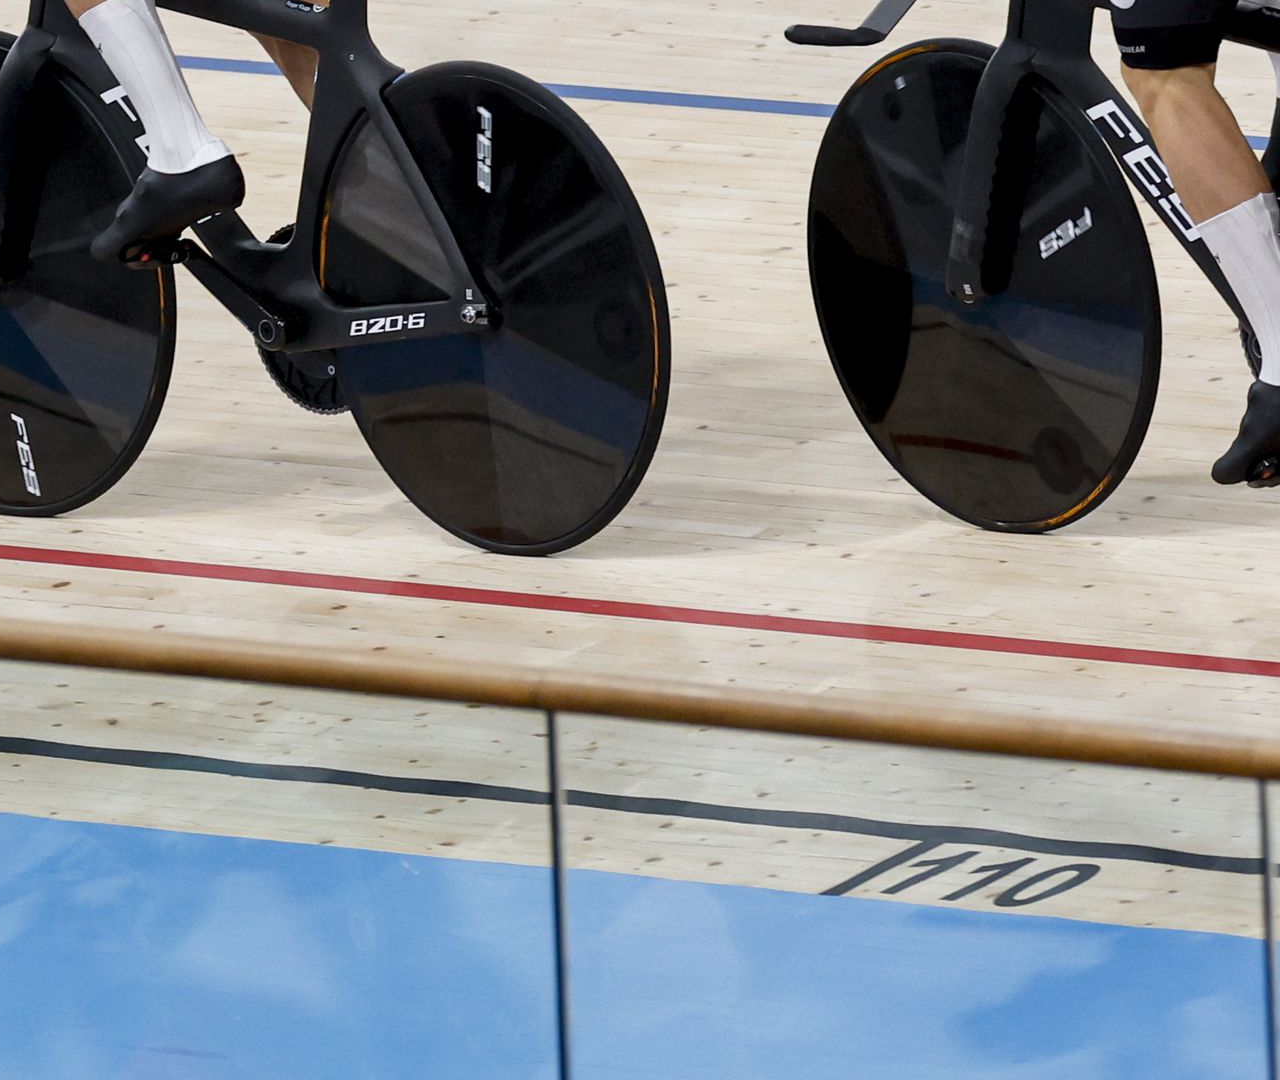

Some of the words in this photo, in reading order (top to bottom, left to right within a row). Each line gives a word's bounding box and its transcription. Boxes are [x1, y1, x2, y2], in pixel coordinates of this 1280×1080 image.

[476, 105, 493, 194] FES
[1038, 205, 1093, 260] FES
[10, 412, 42, 497] FES
[879, 850, 1102, 908] 110
